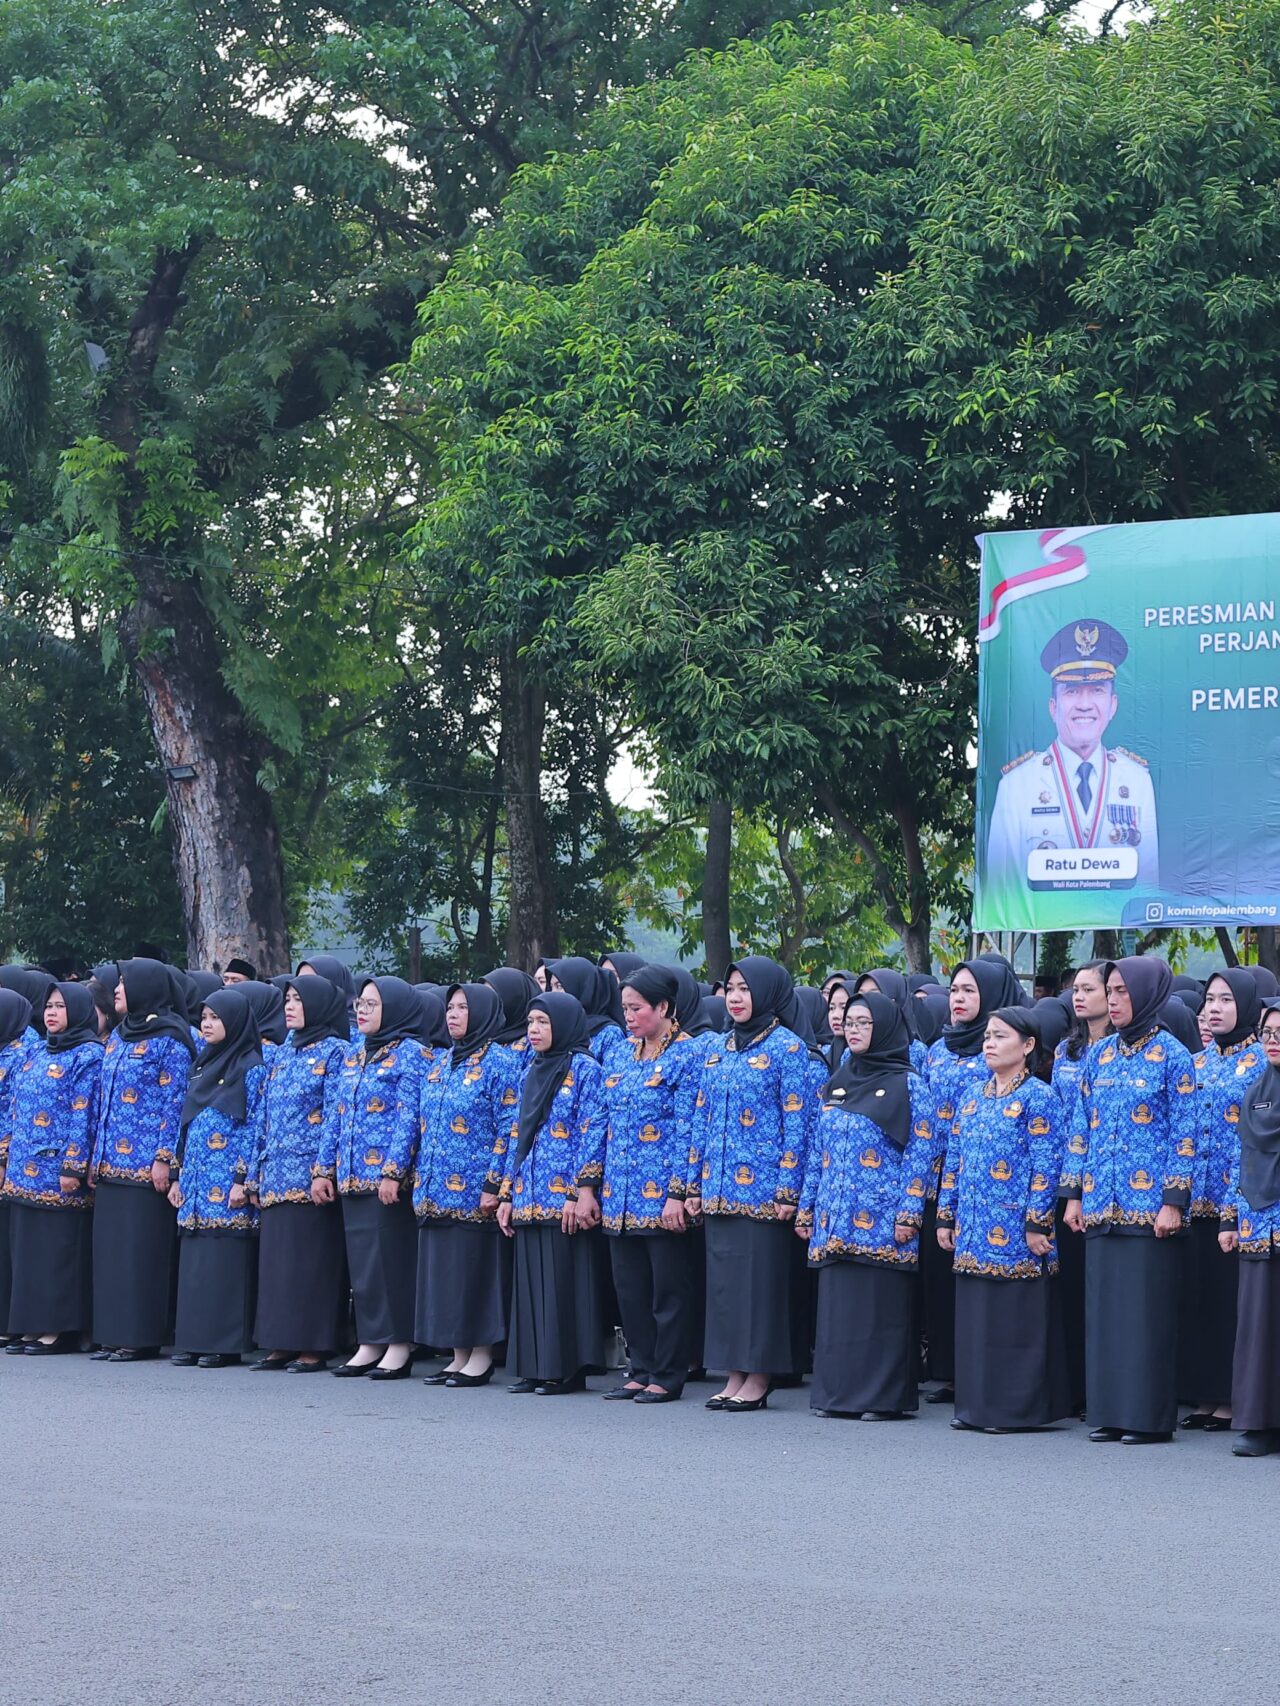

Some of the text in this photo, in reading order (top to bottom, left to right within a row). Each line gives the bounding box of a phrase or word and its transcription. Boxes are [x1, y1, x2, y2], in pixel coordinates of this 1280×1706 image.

[1144, 601, 1274, 628] PERESMIAN
[1045, 858, 1120, 870] Ratu Dewa
[1080, 880, 1111, 889] Palembang
[1167, 904, 1277, 917] kominfopalembang
